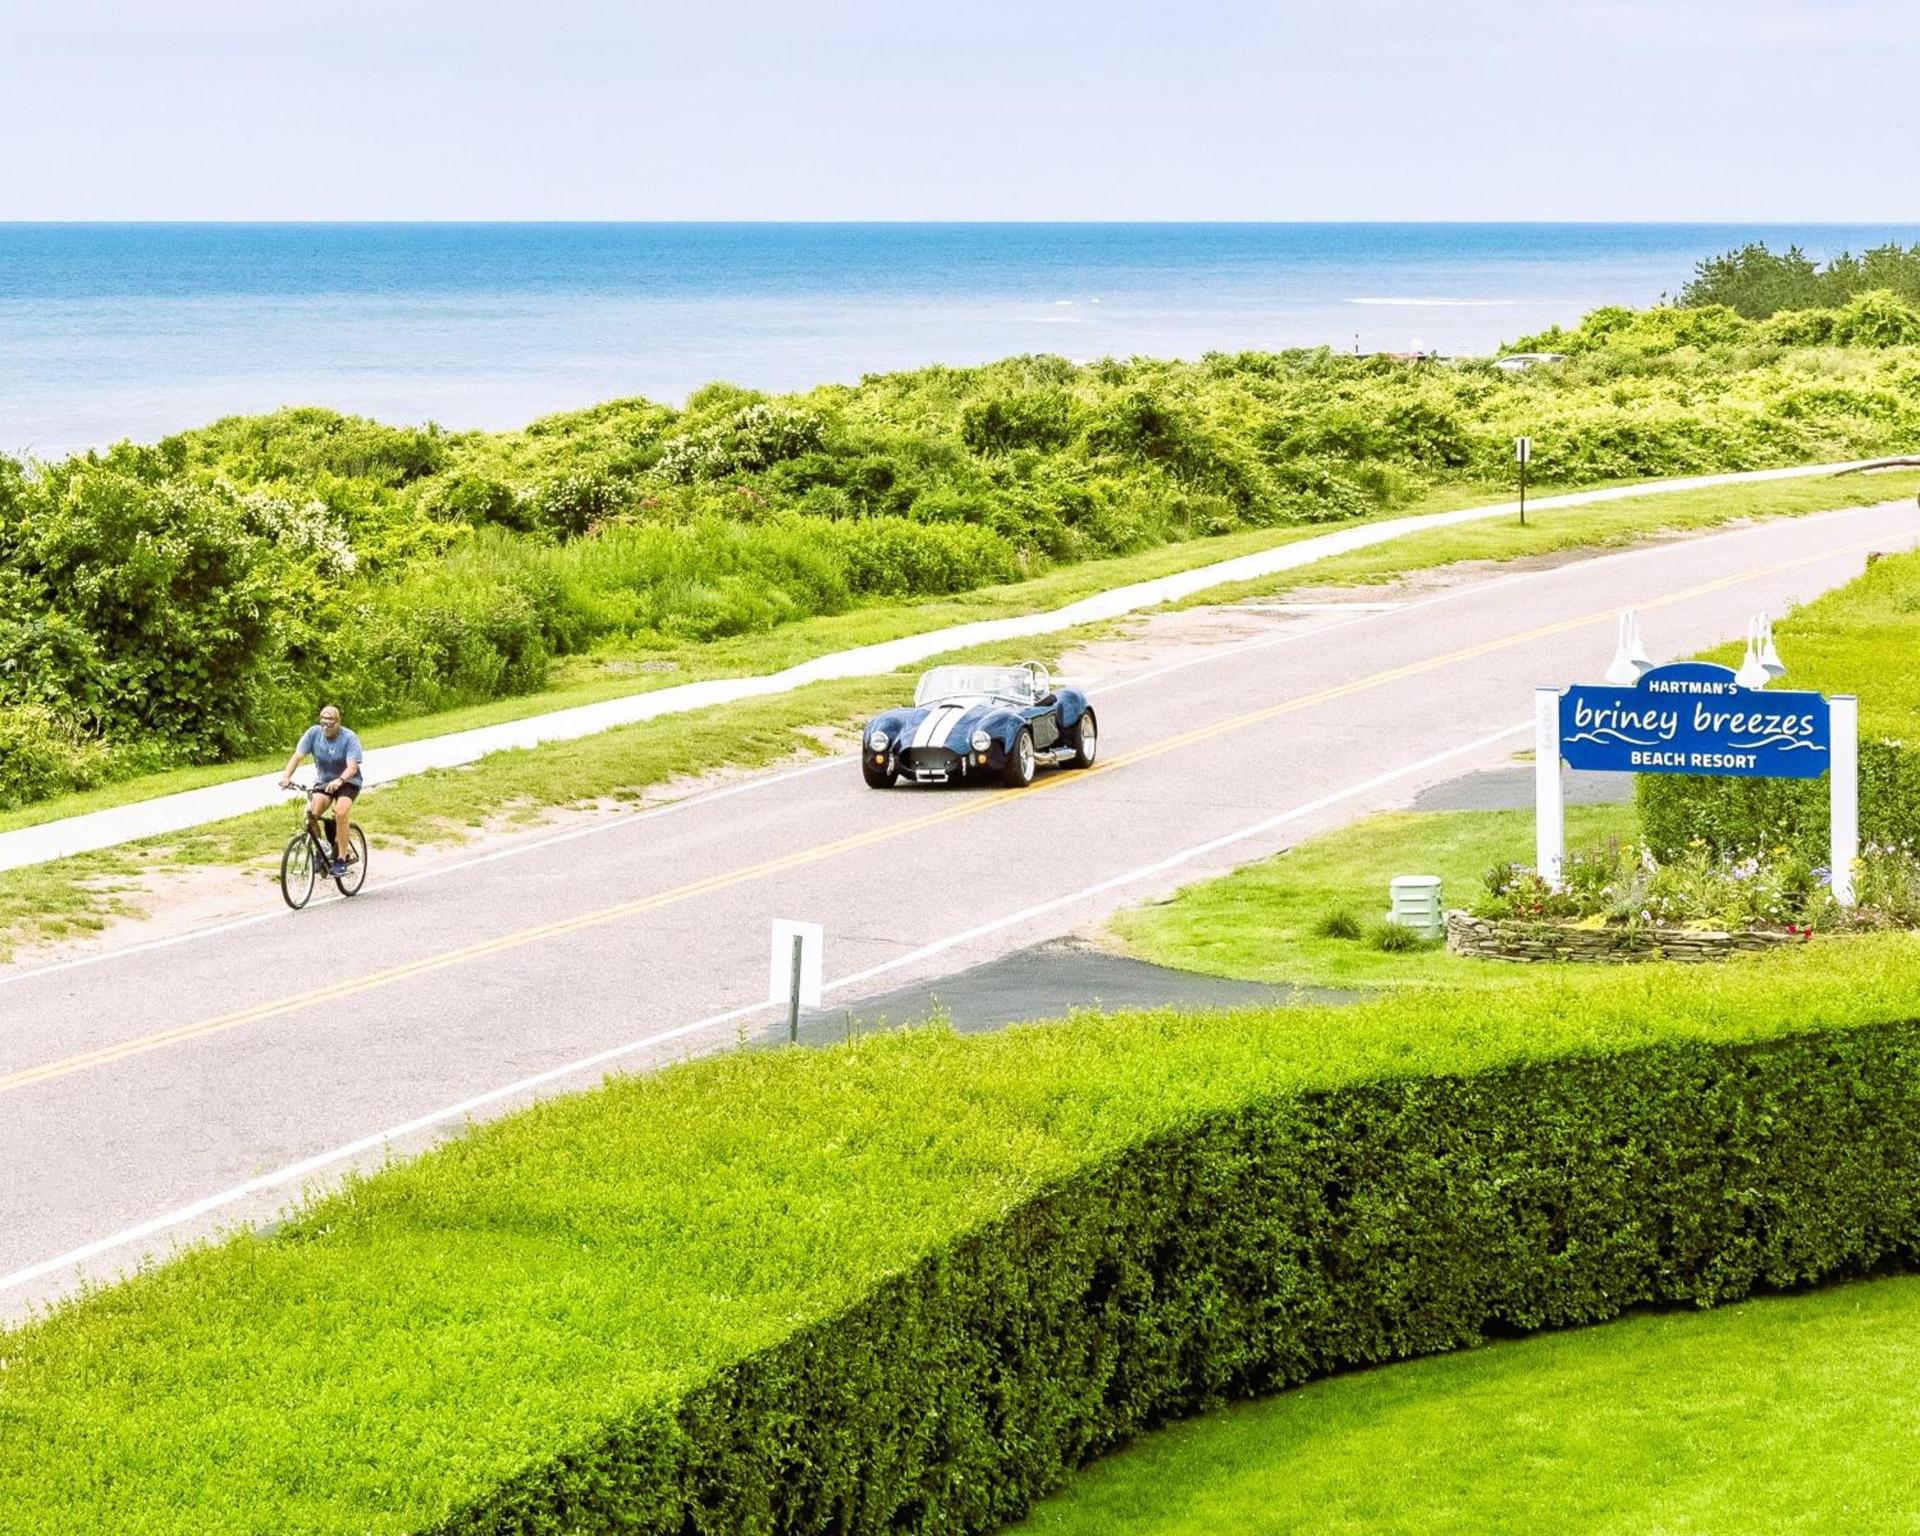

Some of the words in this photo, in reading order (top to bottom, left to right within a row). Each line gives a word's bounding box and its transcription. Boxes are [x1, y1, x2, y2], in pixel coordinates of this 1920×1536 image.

[1648, 680, 1738, 695] HARTMAN'S
[1575, 697, 1678, 740] briney
[1693, 701, 1814, 736] breezes
[1631, 751, 1686, 766] BEACH
[1690, 753, 1757, 769] RESORT
